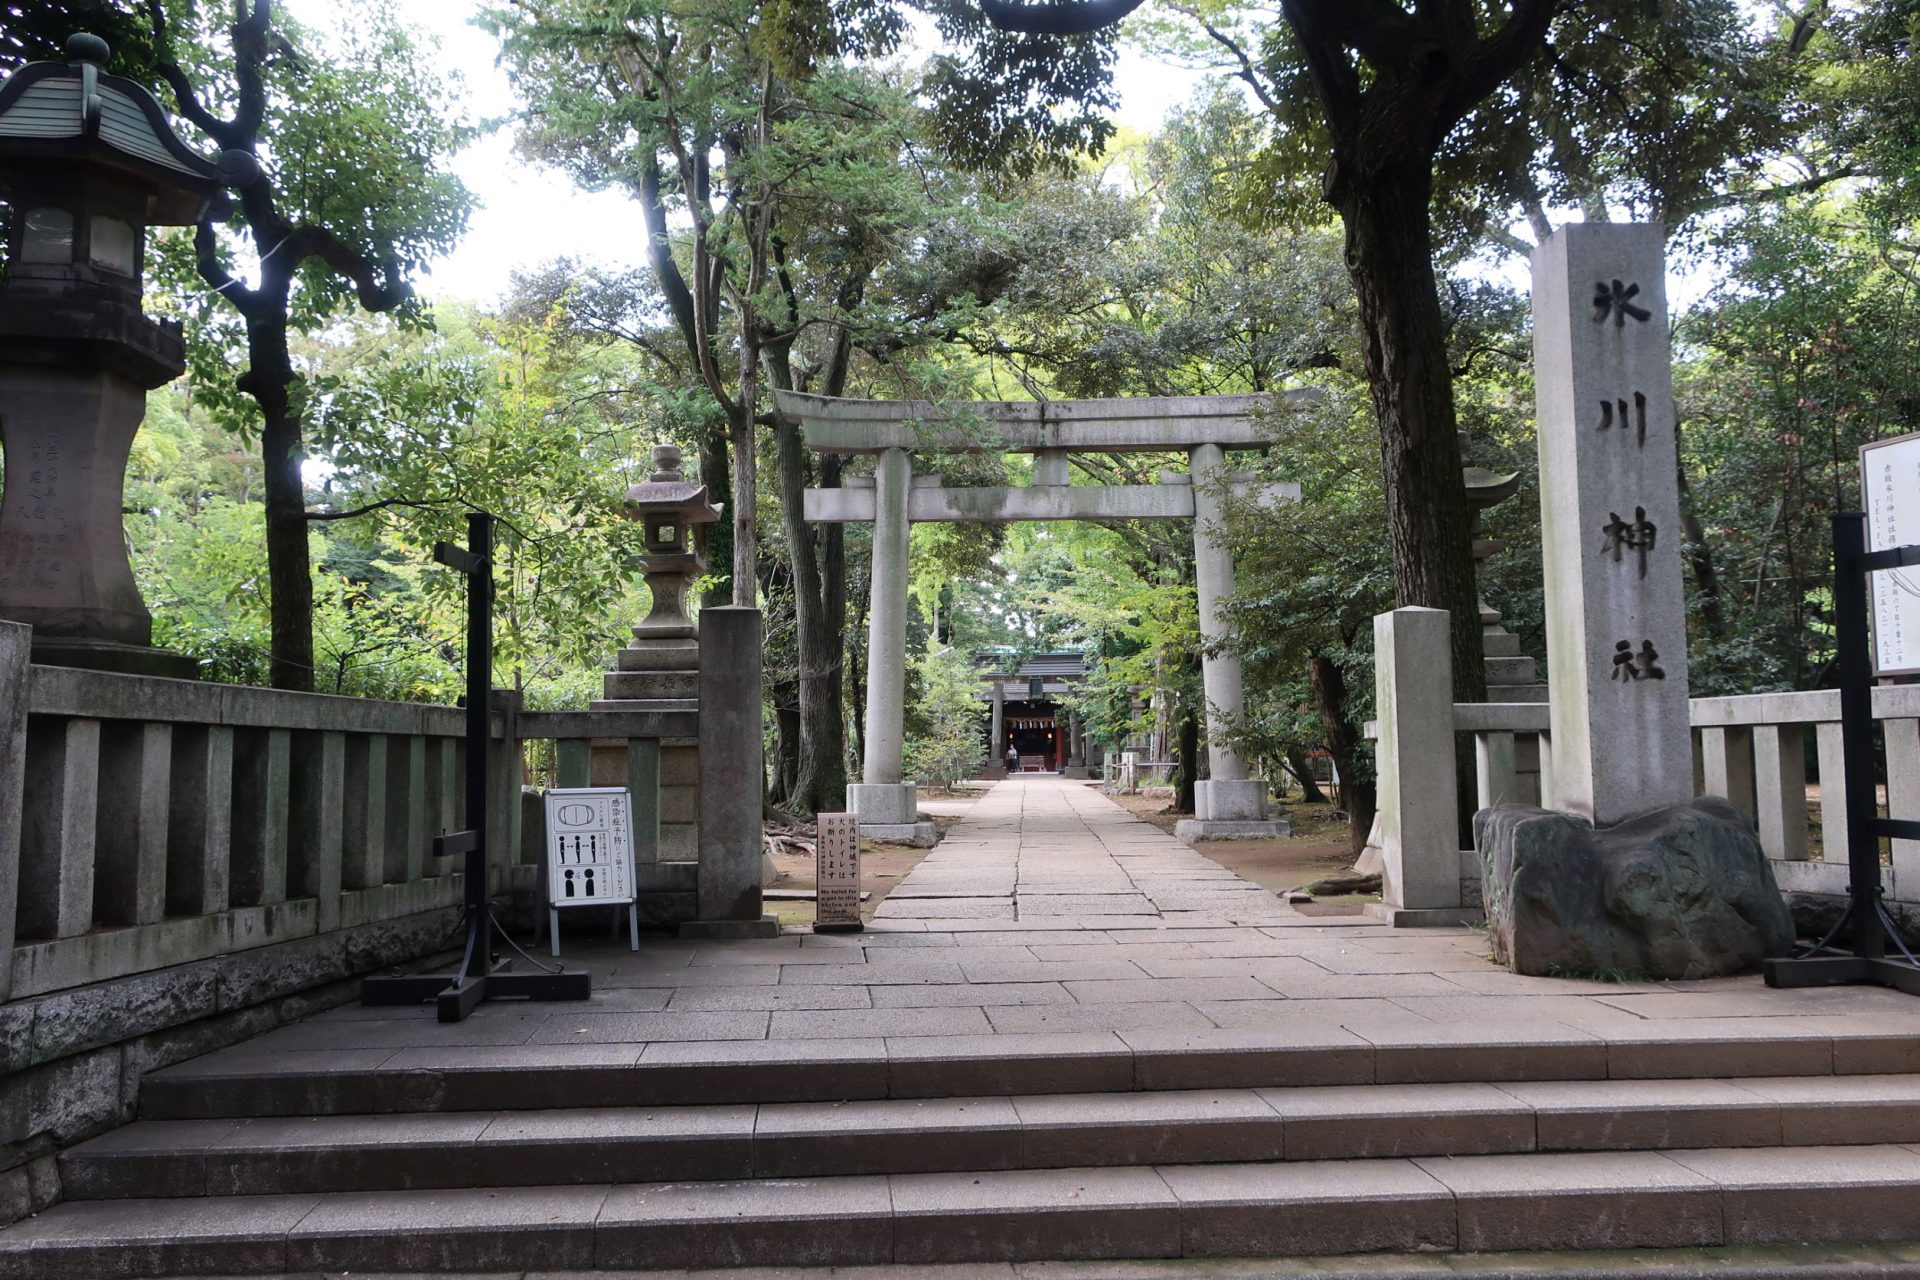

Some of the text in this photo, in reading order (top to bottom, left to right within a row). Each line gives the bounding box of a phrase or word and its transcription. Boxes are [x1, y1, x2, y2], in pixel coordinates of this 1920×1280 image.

[1593, 277, 1667, 682] 氷川神社
[827, 818, 836, 880] お断りします
[848, 817, 857, 879] 境内は神域です
